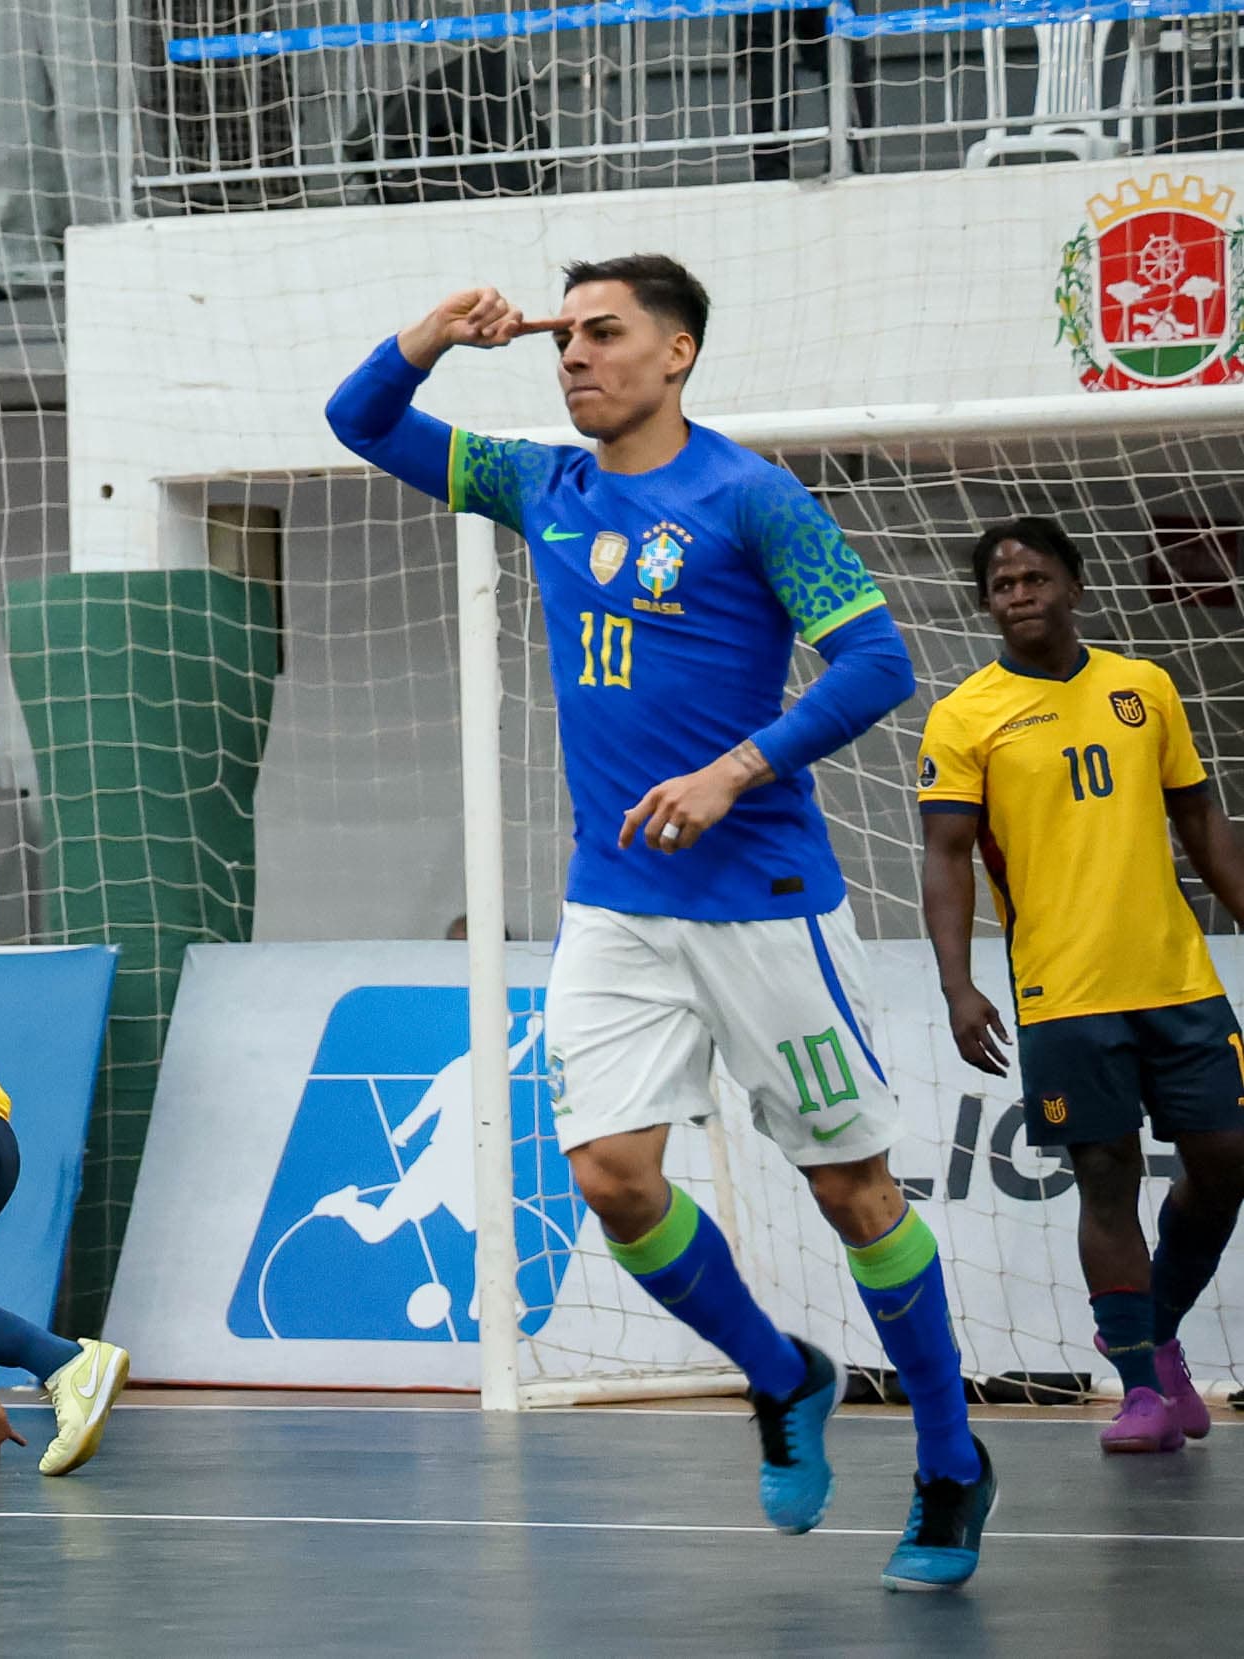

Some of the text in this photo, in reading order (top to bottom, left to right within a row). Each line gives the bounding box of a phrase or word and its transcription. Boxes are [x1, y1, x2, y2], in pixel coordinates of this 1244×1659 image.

[632, 597, 685, 615] BRASIL
[578, 611, 633, 690] 10
[999, 712, 1060, 734] marathon
[1061, 743, 1114, 802] 10
[777, 1026, 860, 1115] 10
[886, 1093, 1188, 1201] IG
